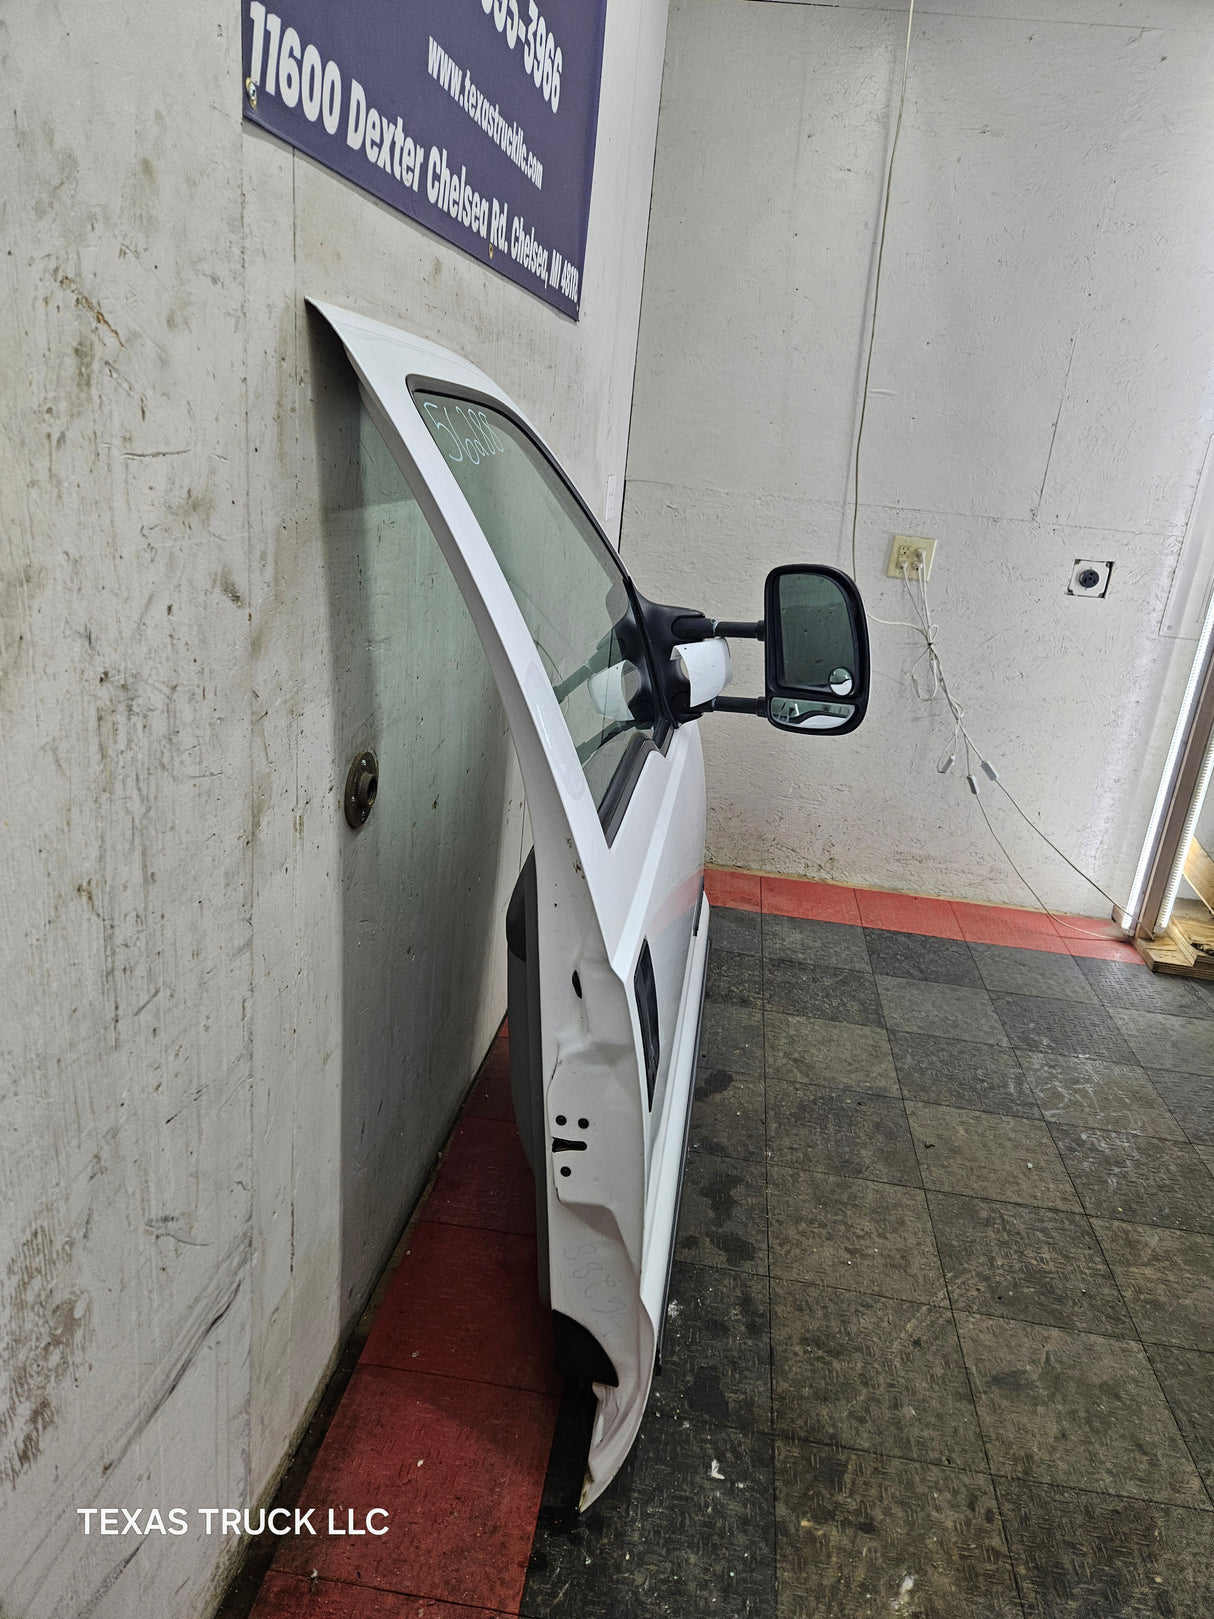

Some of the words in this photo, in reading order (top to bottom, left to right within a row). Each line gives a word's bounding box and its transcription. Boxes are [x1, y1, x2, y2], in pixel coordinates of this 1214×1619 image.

[427, 35, 543, 190] www.texastruckllc.com
[481, 0, 562, 114] 5-3966
[249, 1, 341, 135] 11600
[346, 78, 424, 192] Dexter
[426, 145, 489, 239] Chelsea
[490, 197, 508, 254] Rd.
[511, 216, 548, 290] Chelsea,
[549, 249, 562, 290] MI
[560, 259, 579, 303] 48118
